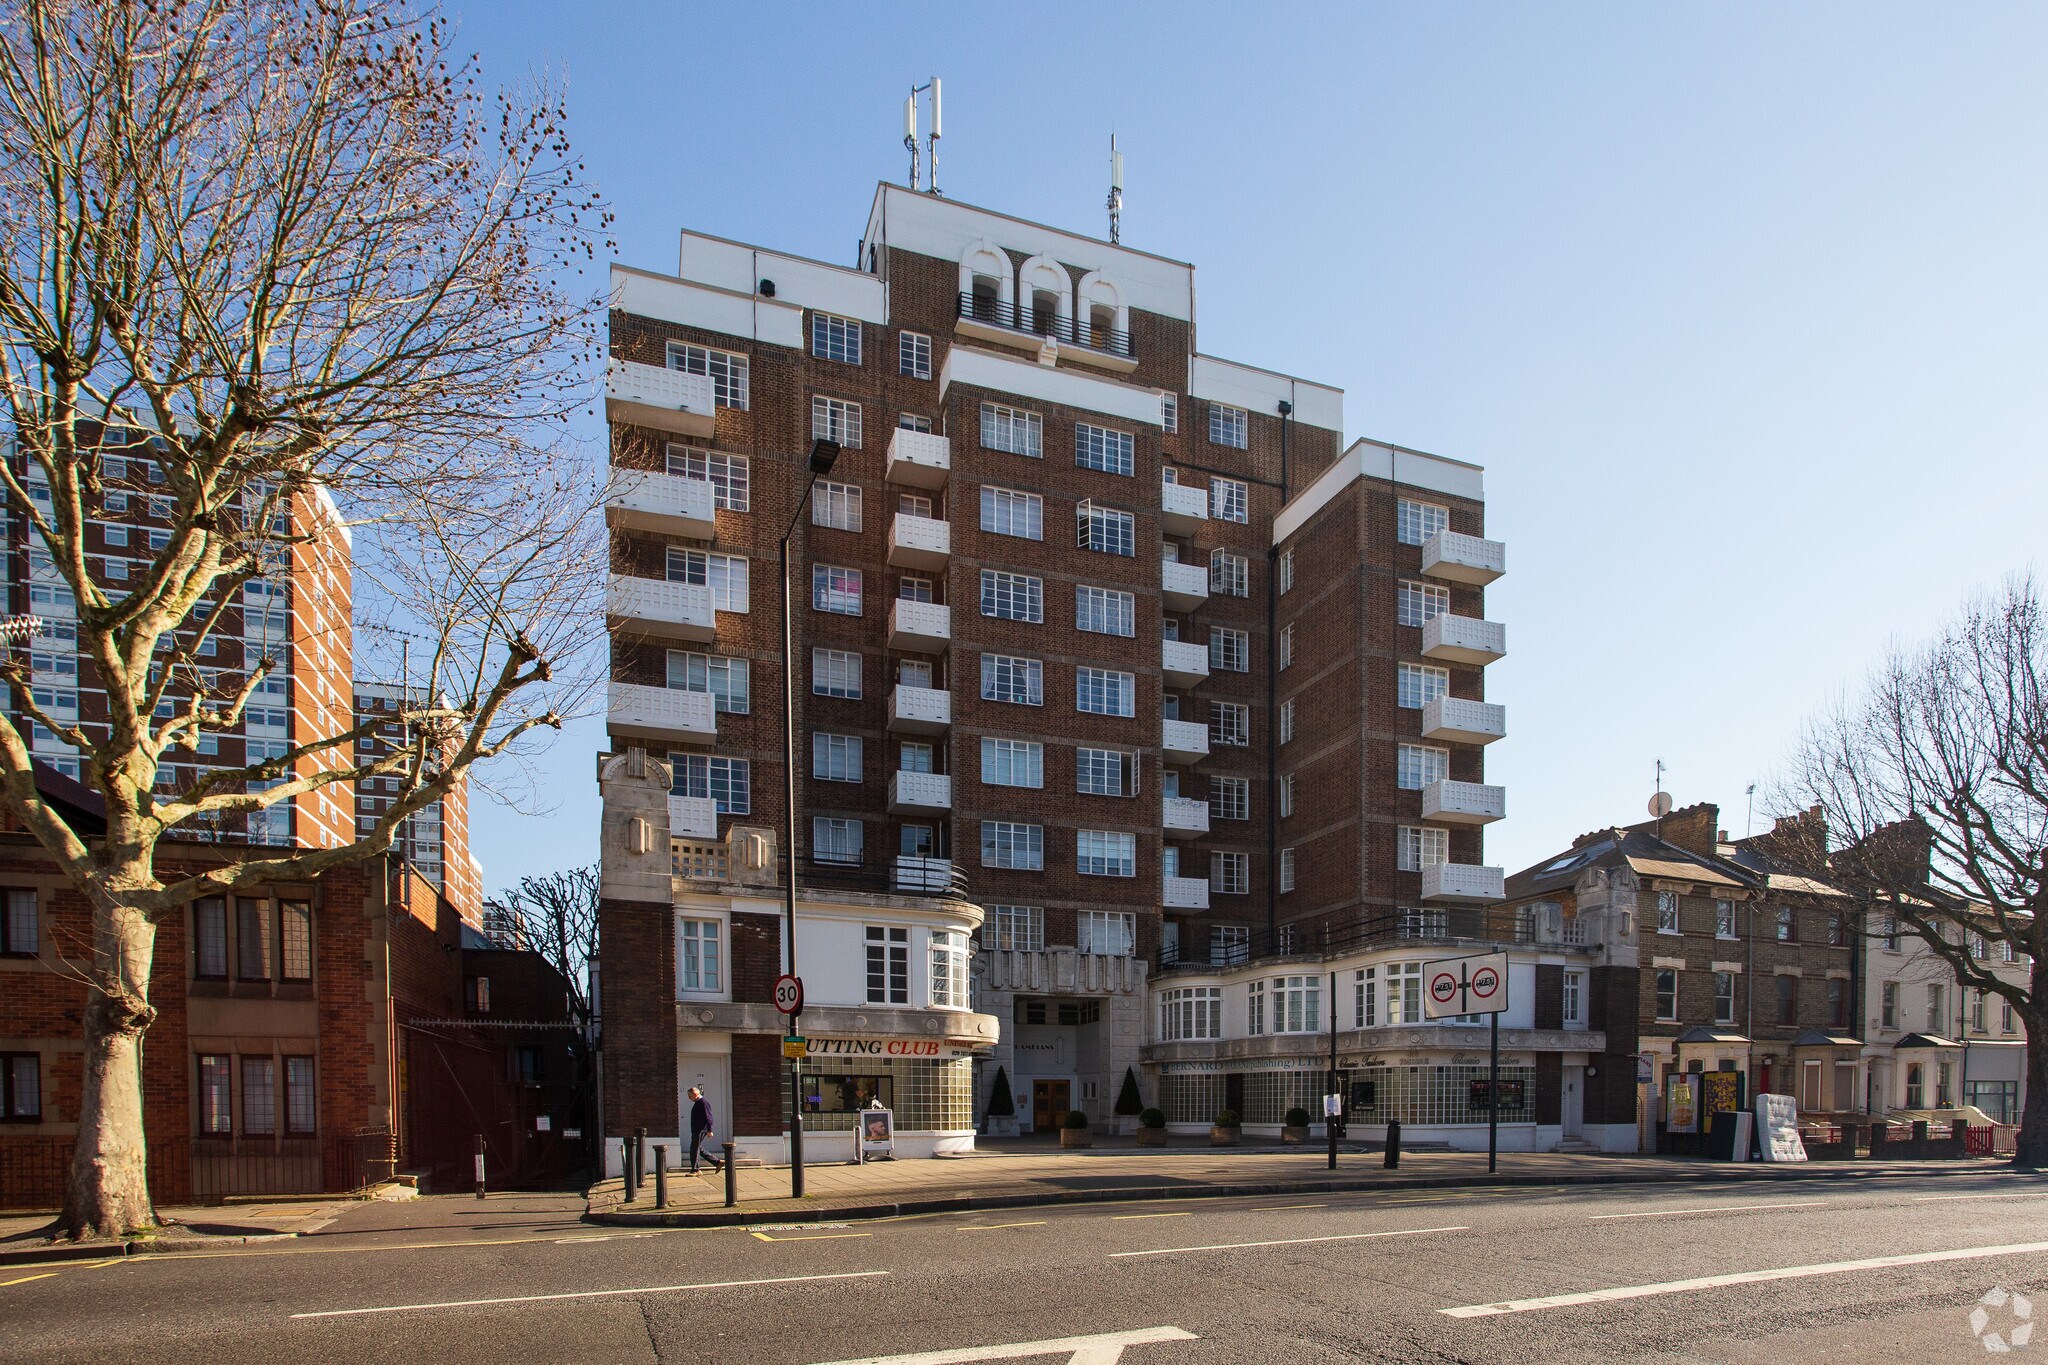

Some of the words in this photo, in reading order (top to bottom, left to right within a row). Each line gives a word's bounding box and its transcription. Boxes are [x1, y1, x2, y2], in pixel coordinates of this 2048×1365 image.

[777, 986, 797, 1003] 30
[806, 1039, 882, 1054] UTTING
[887, 1041, 939, 1055] CLUB
[1171, 1060, 1223, 1071] BERNARD
[1298, 1056, 1324, 1067] LTD
[1451, 1053, 1481, 1066] Classic
